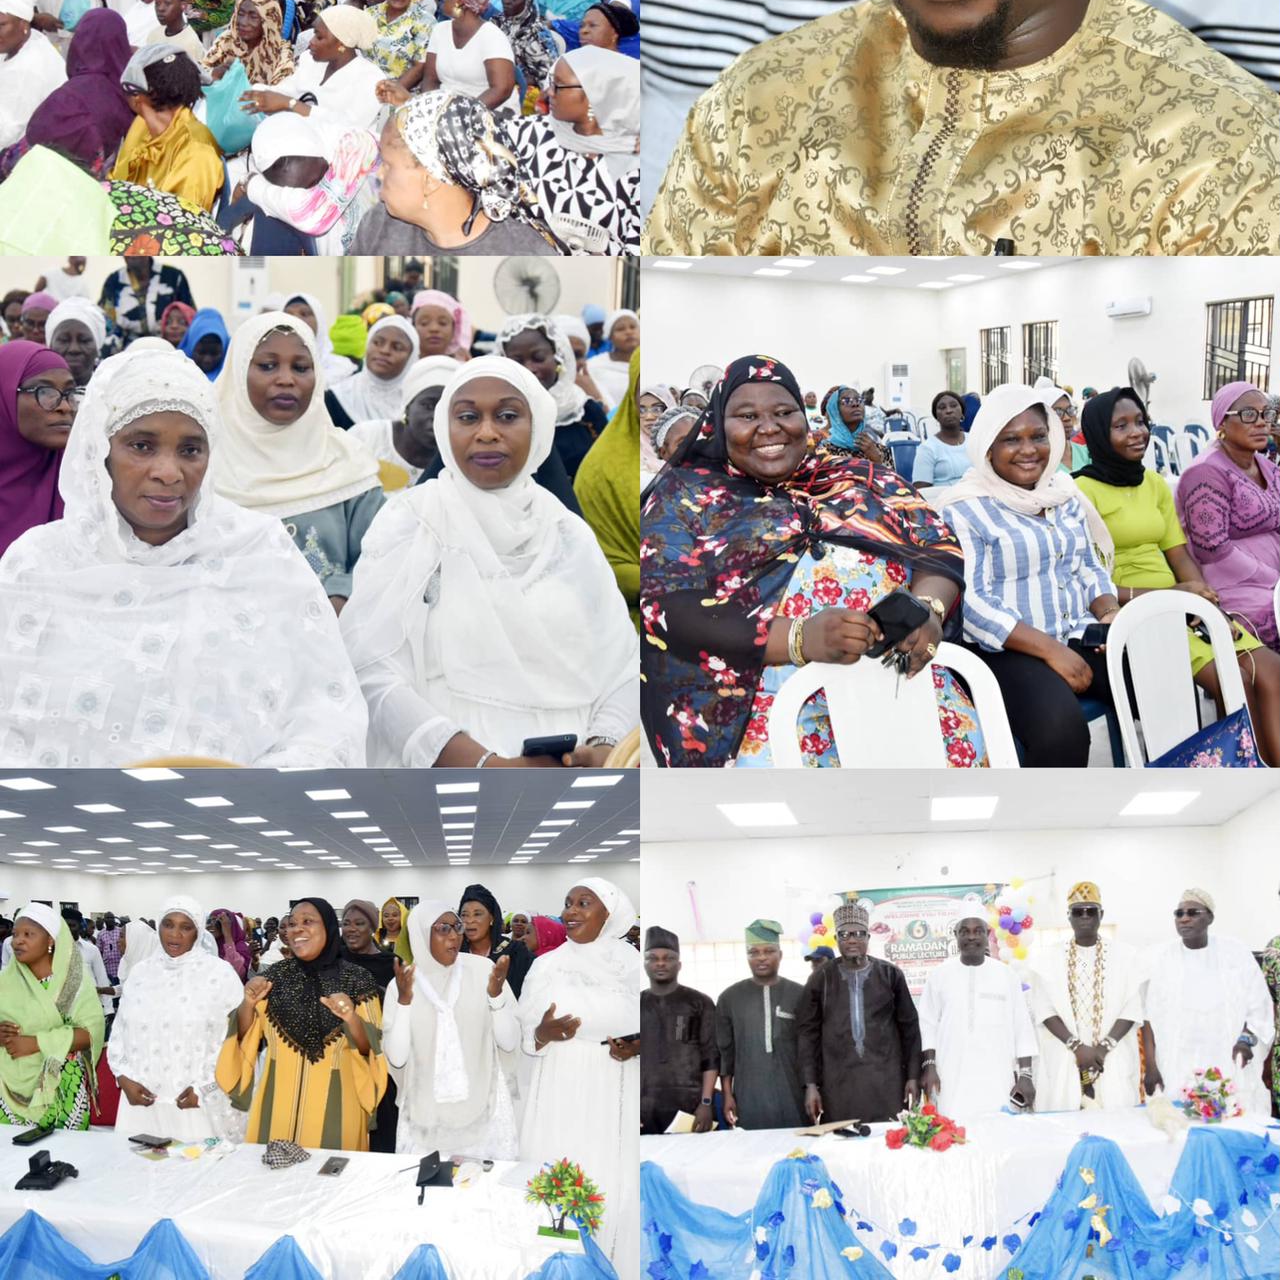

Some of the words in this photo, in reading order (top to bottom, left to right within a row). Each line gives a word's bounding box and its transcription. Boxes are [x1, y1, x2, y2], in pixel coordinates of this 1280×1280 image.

[891, 941, 947, 953] RAMADAN
[892, 951, 917, 960] PUBLIC
[918, 951, 946, 959] LECTURE
